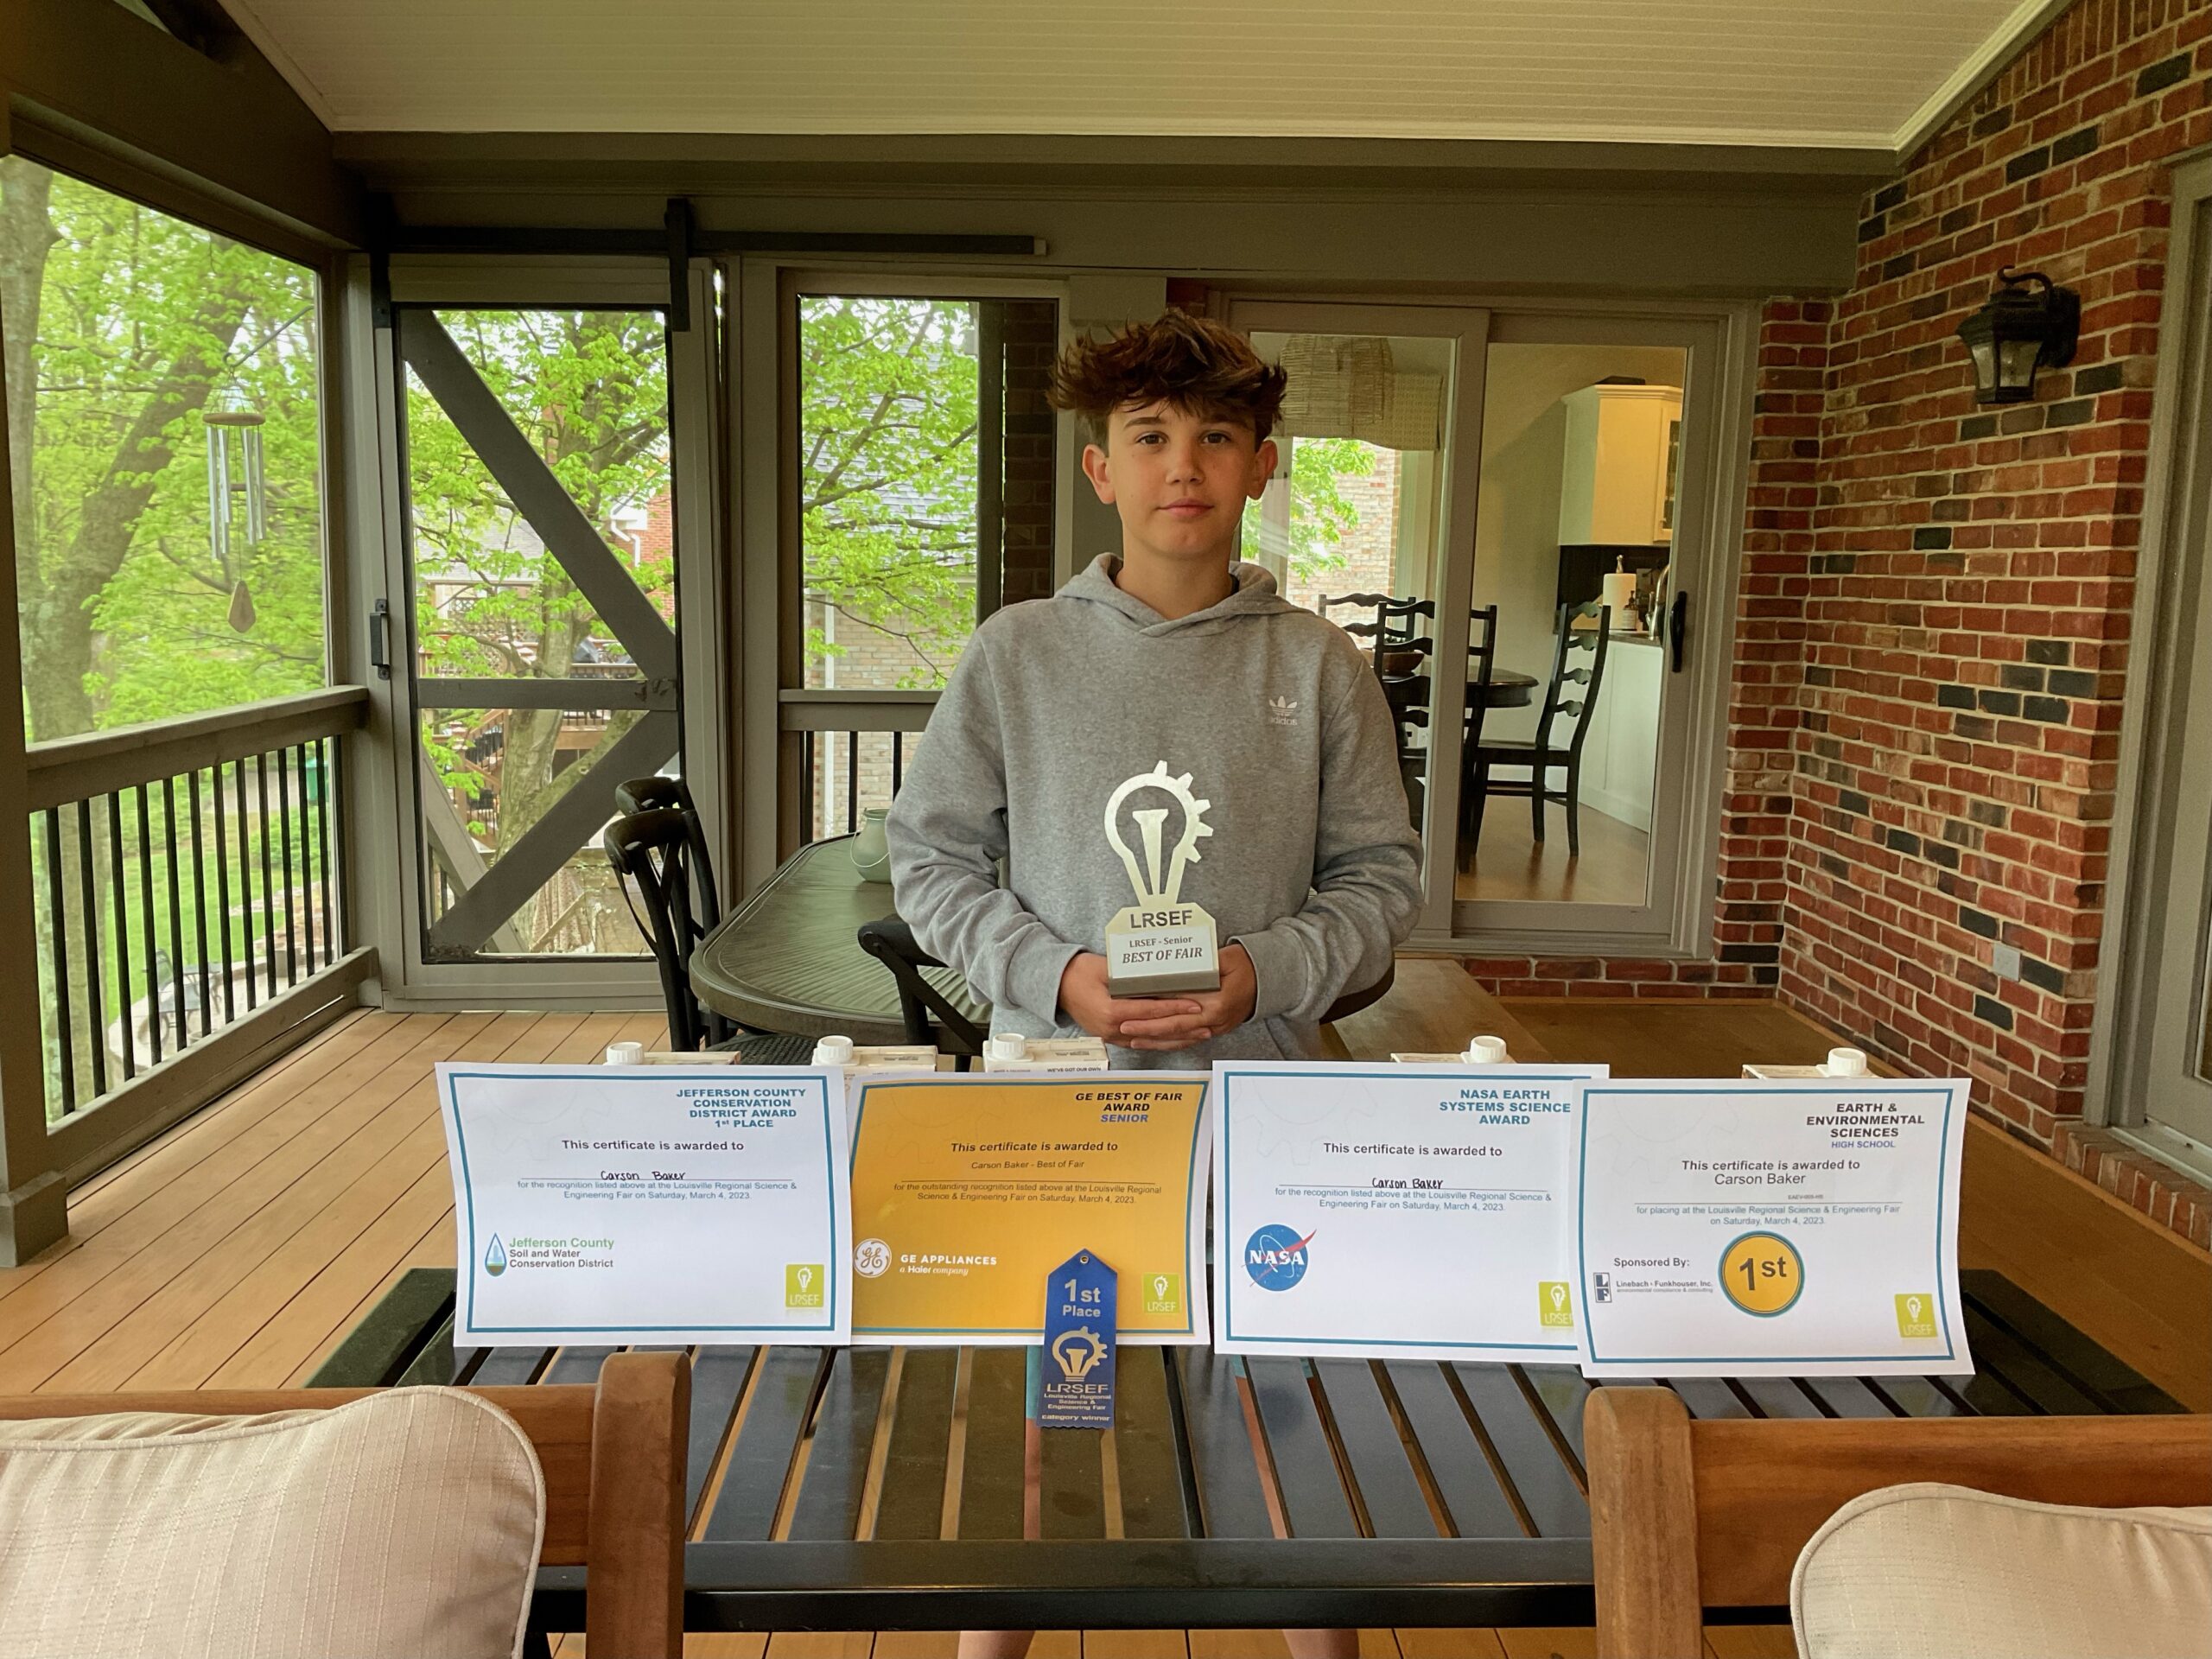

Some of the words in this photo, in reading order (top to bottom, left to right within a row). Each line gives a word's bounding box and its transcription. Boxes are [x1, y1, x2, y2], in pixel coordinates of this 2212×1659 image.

[1270, 716, 1297, 726] adidas
[1130, 909, 1192, 928] LRSEF
[1129, 938, 1156, 948] LRSEF
[1163, 935, 1192, 944] Senior
[1122, 950, 1153, 963] BEST
[1155, 949, 1172, 960] OF
[1174, 947, 1202, 959] FAIR
[676, 1089, 749, 1097] JEFFERSON
[1075, 1092, 1093, 1101] GE
[1096, 1092, 1130, 1101] BEST
[1154, 1092, 1182, 1101] FAIR
[1460, 1089, 1498, 1099] NASA
[1503, 1090, 1549, 1099] EARTH
[693, 1098, 791, 1107] CONSERVATION
[1103, 1103, 1149, 1111] AWARD
[1439, 1101, 1504, 1111] SYSTEMS
[1509, 1102, 1570, 1112] SCIENCE
[1836, 1103, 1883, 1112] EARTH
[1887, 1103, 1897, 1112] &
[751, 1109, 797, 1117] AWARD
[1100, 1112, 1148, 1122] SENIOR
[715, 1119, 729, 1128] 1st
[733, 1119, 773, 1128] PLACE
[1478, 1115, 1530, 1124] AWARD
[1806, 1115, 1924, 1125] ENVIRONMENTAL
[1830, 1128, 1898, 1138] SCIENCES
[561, 1140, 589, 1149] This
[593, 1140, 655, 1149] certificate
[658, 1141, 670, 1150] is
[674, 1141, 728, 1150] awarded
[731, 1141, 744, 1150] to
[950, 1142, 976, 1152] This
[979, 1141, 1037, 1151] certificate
[1040, 1141, 1051, 1150] is
[1053, 1141, 1103, 1151] awarded
[1105, 1142, 1117, 1151] to
[1323, 1142, 1350, 1153] This
[1353, 1143, 1414, 1154] certificate
[1419, 1144, 1429, 1154] is
[1433, 1144, 1485, 1156] awarded
[1490, 1147, 1502, 1156] to
[1855, 1140, 1896, 1148] SCHOOL
[1036, 1160, 1056, 1168] Best
[1681, 1160, 1708, 1170] This
[1712, 1160, 1774, 1170] certificate
[1777, 1160, 1788, 1170] is
[1791, 1159, 1844, 1170] awarded
[1848, 1160, 1859, 1169] to
[601, 1170, 639, 1181] Carson
[652, 1171, 685, 1181] Baker
[1714, 1173, 1762, 1185] Carson
[1767, 1173, 1806, 1184] Baker
[546, 1181, 593, 1191] recognition
[715, 1181, 753, 1191] Regional
[1372, 1177, 1407, 1189] Carson
[1412, 1178, 1443, 1189] Baker
[563, 1191, 613, 1200] Engineering
[960, 1193, 1007, 1202] Engineering
[1302, 1188, 1348, 1198] recognition
[1351, 1188, 1373, 1197] listed
[1374, 1189, 1402, 1198] above
[1402, 1189, 1412, 1198] at
[1413, 1189, 1426, 1198] the
[1428, 1190, 1467, 1199] Louisville
[1469, 1191, 1506, 1202] Regional
[1509, 1192, 1542, 1201] Science
[1319, 1198, 1369, 1210] Engineering
[1370, 1199, 1387, 1208] Fair
[1764, 1216, 1790, 1224] March
[510, 1236, 567, 1249] Jefferson
[571, 1236, 614, 1250] County
[900, 1254, 916, 1263] GE
[920, 1255, 996, 1265] APPLIANCES
[1249, 1250, 1305, 1265] NASA
[1613, 1257, 1669, 1268] Sponsored
[1673, 1257, 1689, 1268] By:
[509, 1259, 575, 1268] Conservation
[578, 1259, 613, 1268] District
[907, 1265, 931, 1274] Haier
[932, 1268, 969, 1276] company
[1739, 1255, 1787, 1291] 1st
[1065, 1278, 1101, 1303] 1st
[790, 1294, 819, 1306] LRSEF
[1062, 1304, 1101, 1318] Place
[1147, 1300, 1177, 1312] LRSEF
[1904, 1324, 1933, 1336] LRSEF
[1046, 1383, 1109, 1394] LRSEF
